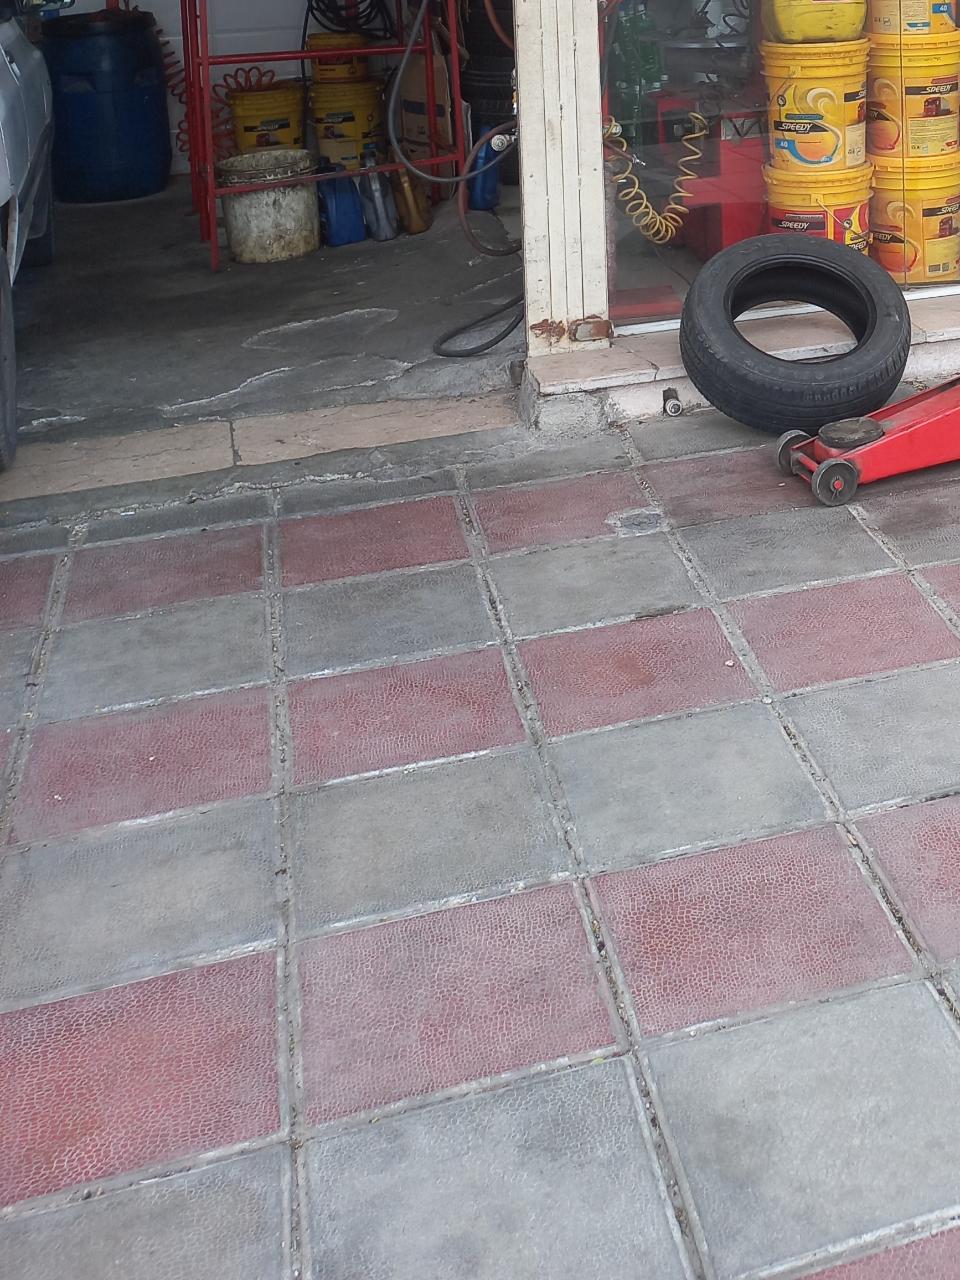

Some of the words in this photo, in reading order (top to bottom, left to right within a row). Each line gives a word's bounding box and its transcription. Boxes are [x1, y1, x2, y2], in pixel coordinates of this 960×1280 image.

[920, 84, 952, 94] SPEEDY
[779, 122, 813, 131] SPEEDY
[779, 221, 810, 230] SPEEDY
